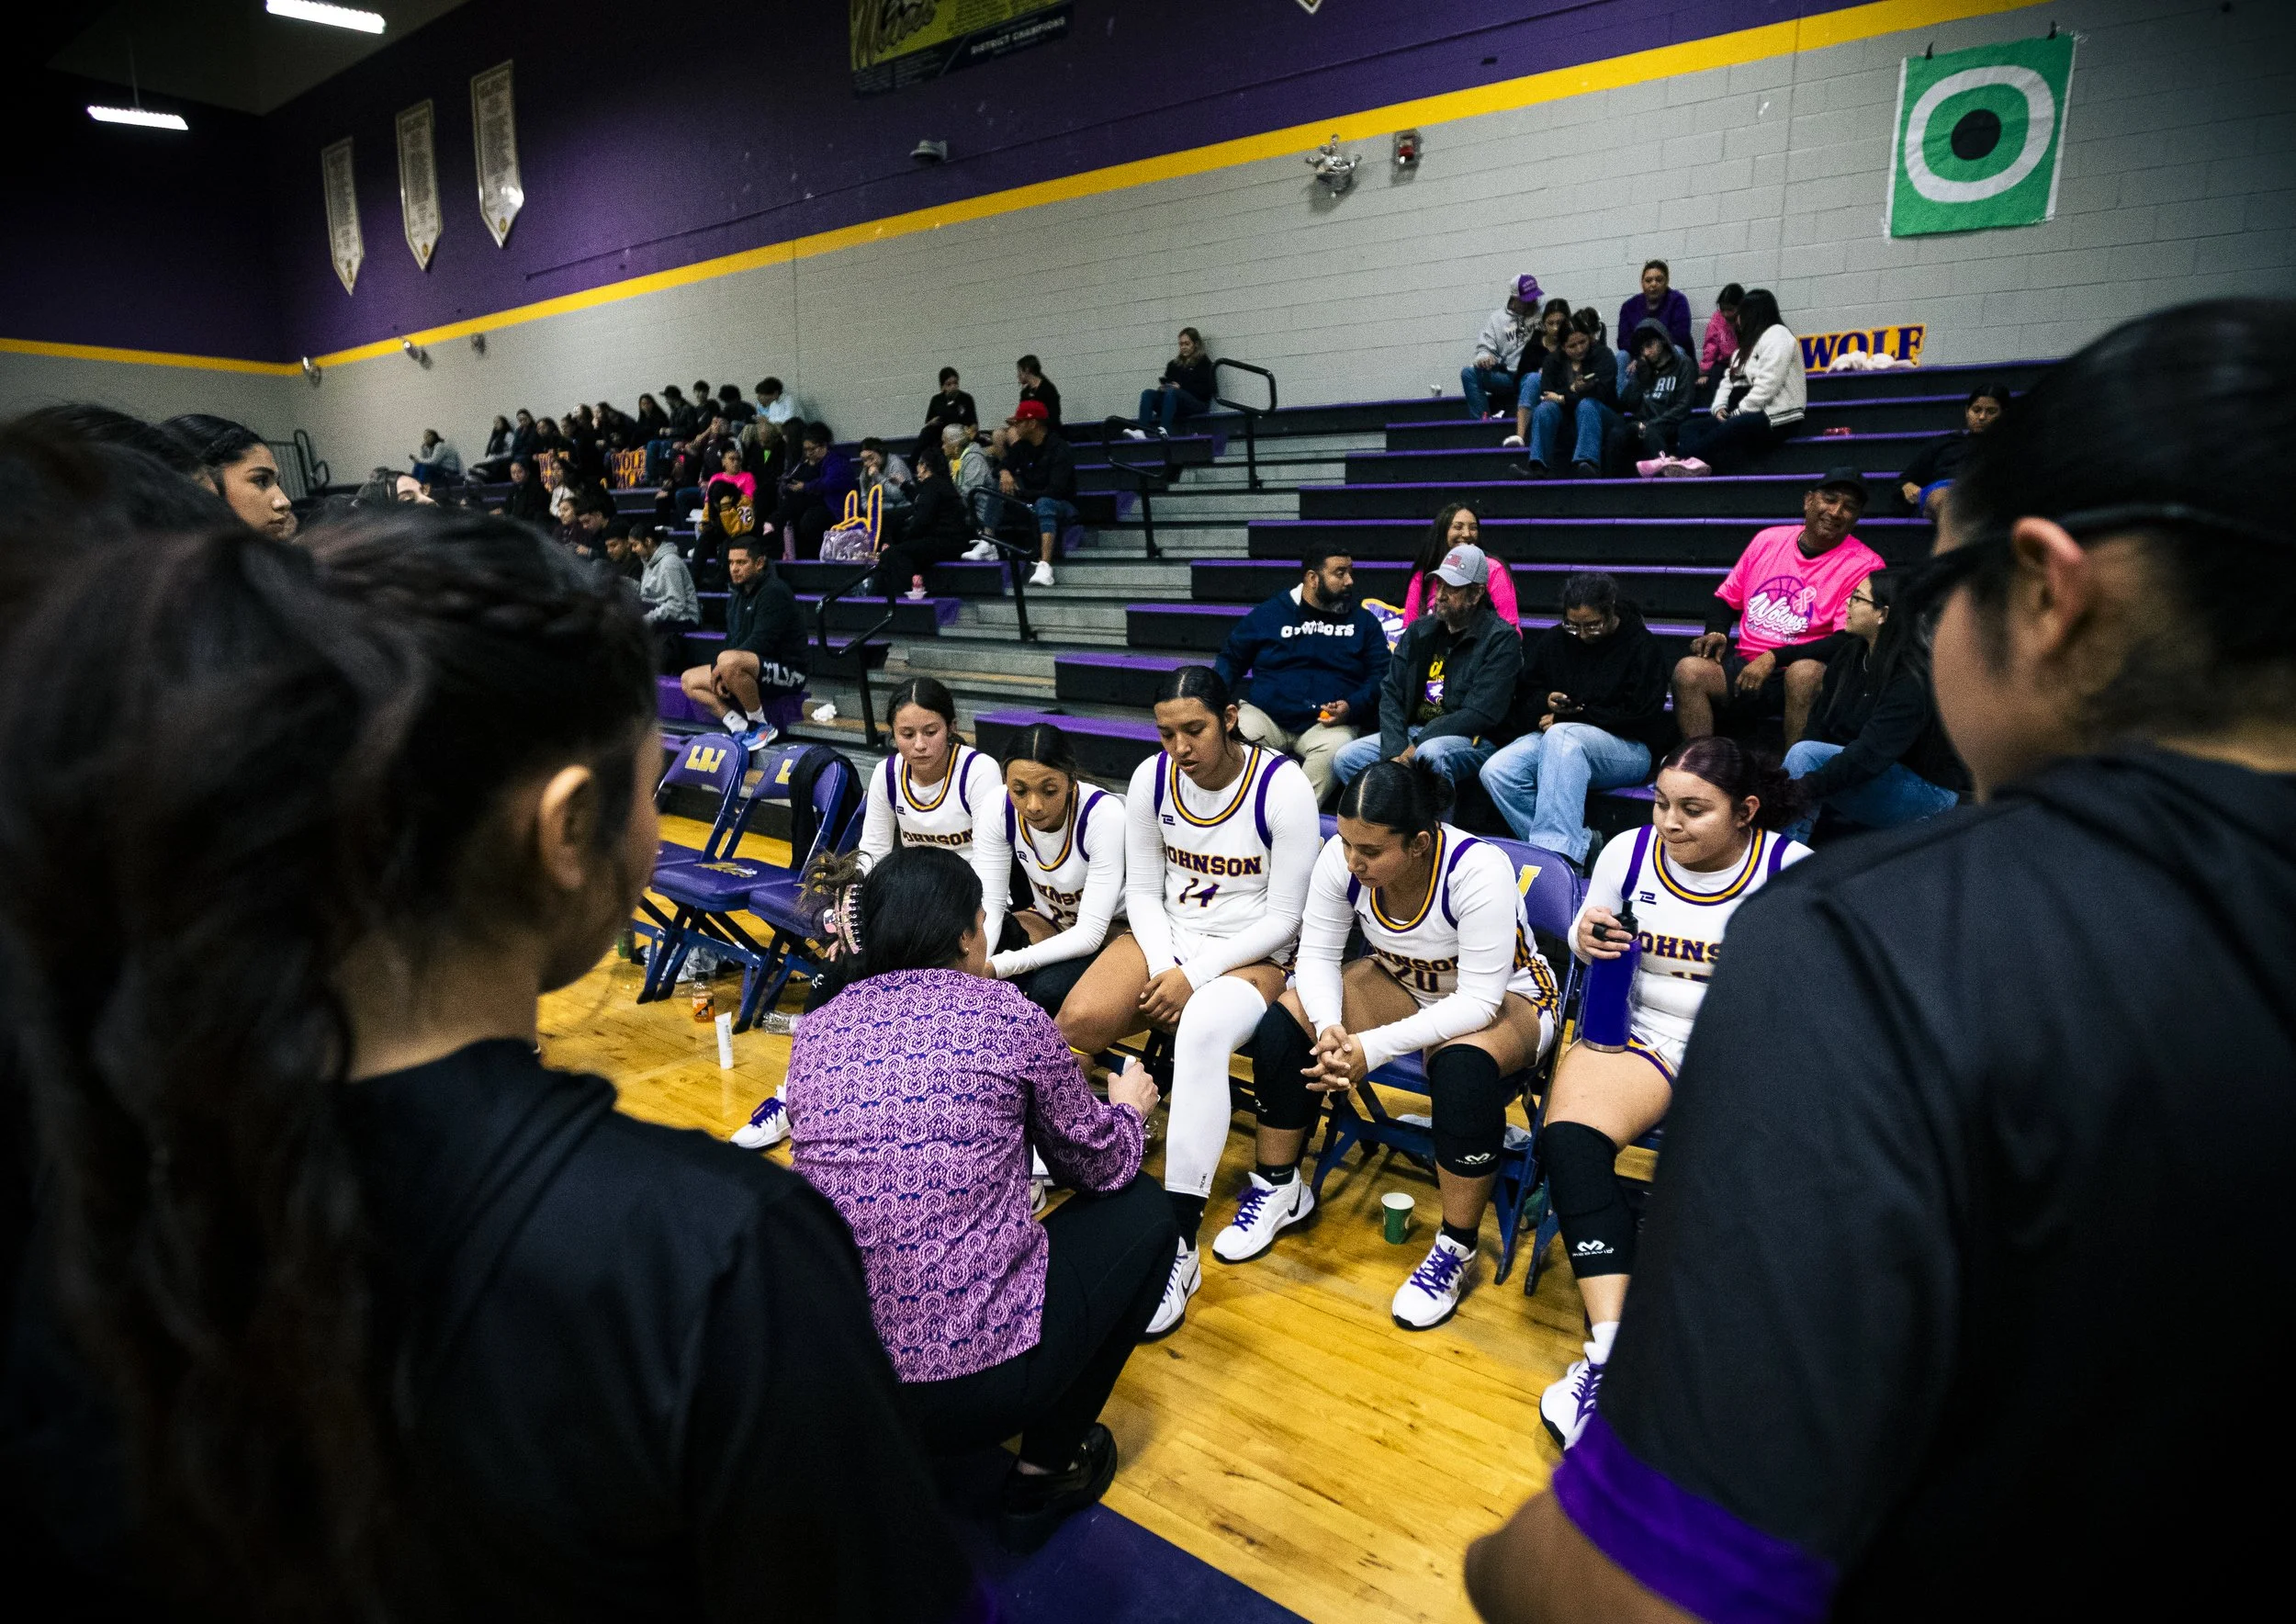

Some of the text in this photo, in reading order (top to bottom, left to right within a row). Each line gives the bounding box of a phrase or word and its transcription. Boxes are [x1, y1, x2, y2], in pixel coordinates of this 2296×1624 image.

[1798, 326, 1924, 369] WOLF
[1748, 592, 1808, 635] Wolves
[901, 828, 973, 846] OHNSON
[1165, 844, 1263, 878] OHNSON
[1178, 876, 1221, 908] 14
[1638, 930, 1721, 964] OHNS
